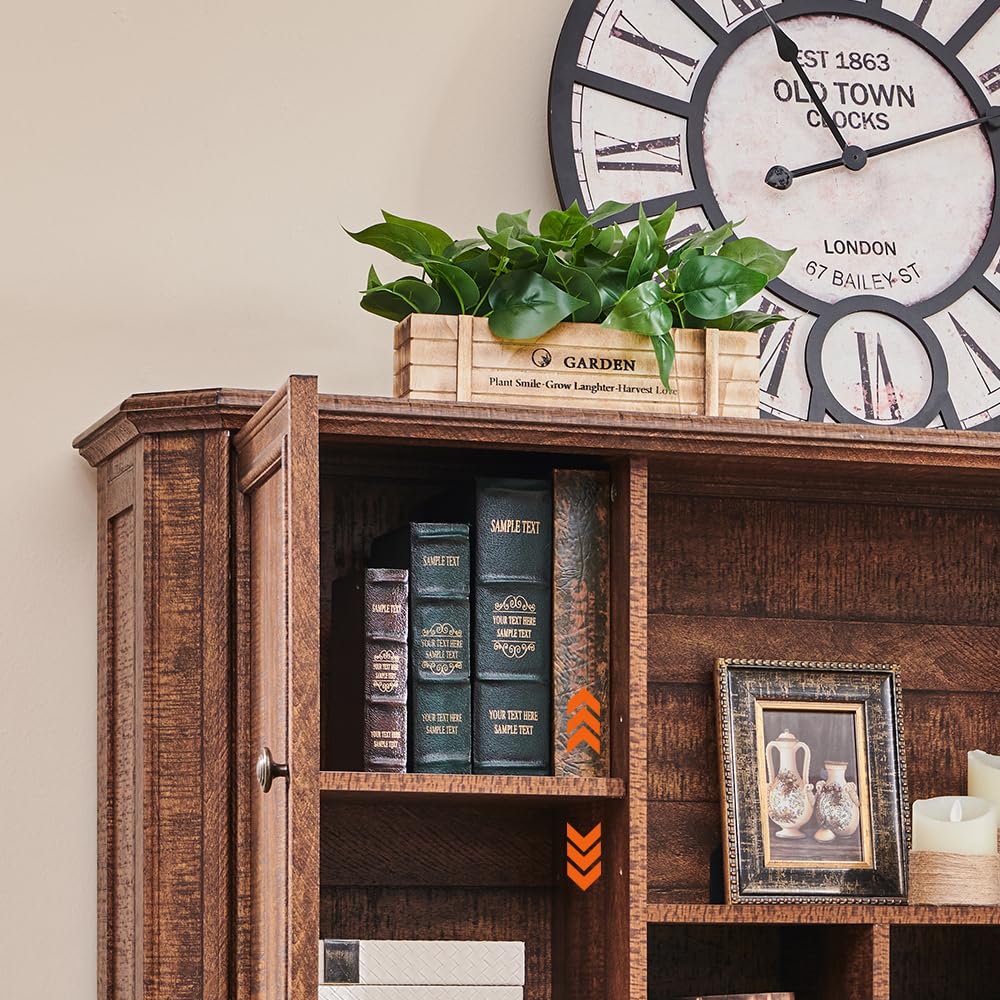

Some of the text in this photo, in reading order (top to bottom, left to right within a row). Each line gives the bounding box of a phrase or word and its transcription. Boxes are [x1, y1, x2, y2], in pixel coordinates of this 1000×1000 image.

[835, 51, 890, 72] 1863
[773, 79, 916, 108] OLD TOWN
[824, 240, 896, 256] LONDON
[806, 260, 921, 290] 67 BAILEY ST
[564, 356, 636, 372] GARDEN
[489, 377, 513, 387] Plant
[490, 520, 540, 535] SAMPLE TEXT
[423, 556, 460, 566] SAMPLE TEXT
[372, 604, 390, 613] SAMPLE
[492, 615, 536, 626] YOUR TEXT HERE
[496, 628, 532, 638] SAMPLE TEXT
[446, 650, 458, 658] TEXT
[437, 714, 449, 722] TEXT
[488, 710, 538, 722] YOUR TEXT HERE
[426, 726, 458, 735] SAMPLE TEXT
[494, 724, 534, 736] SAMPLE TEXT
